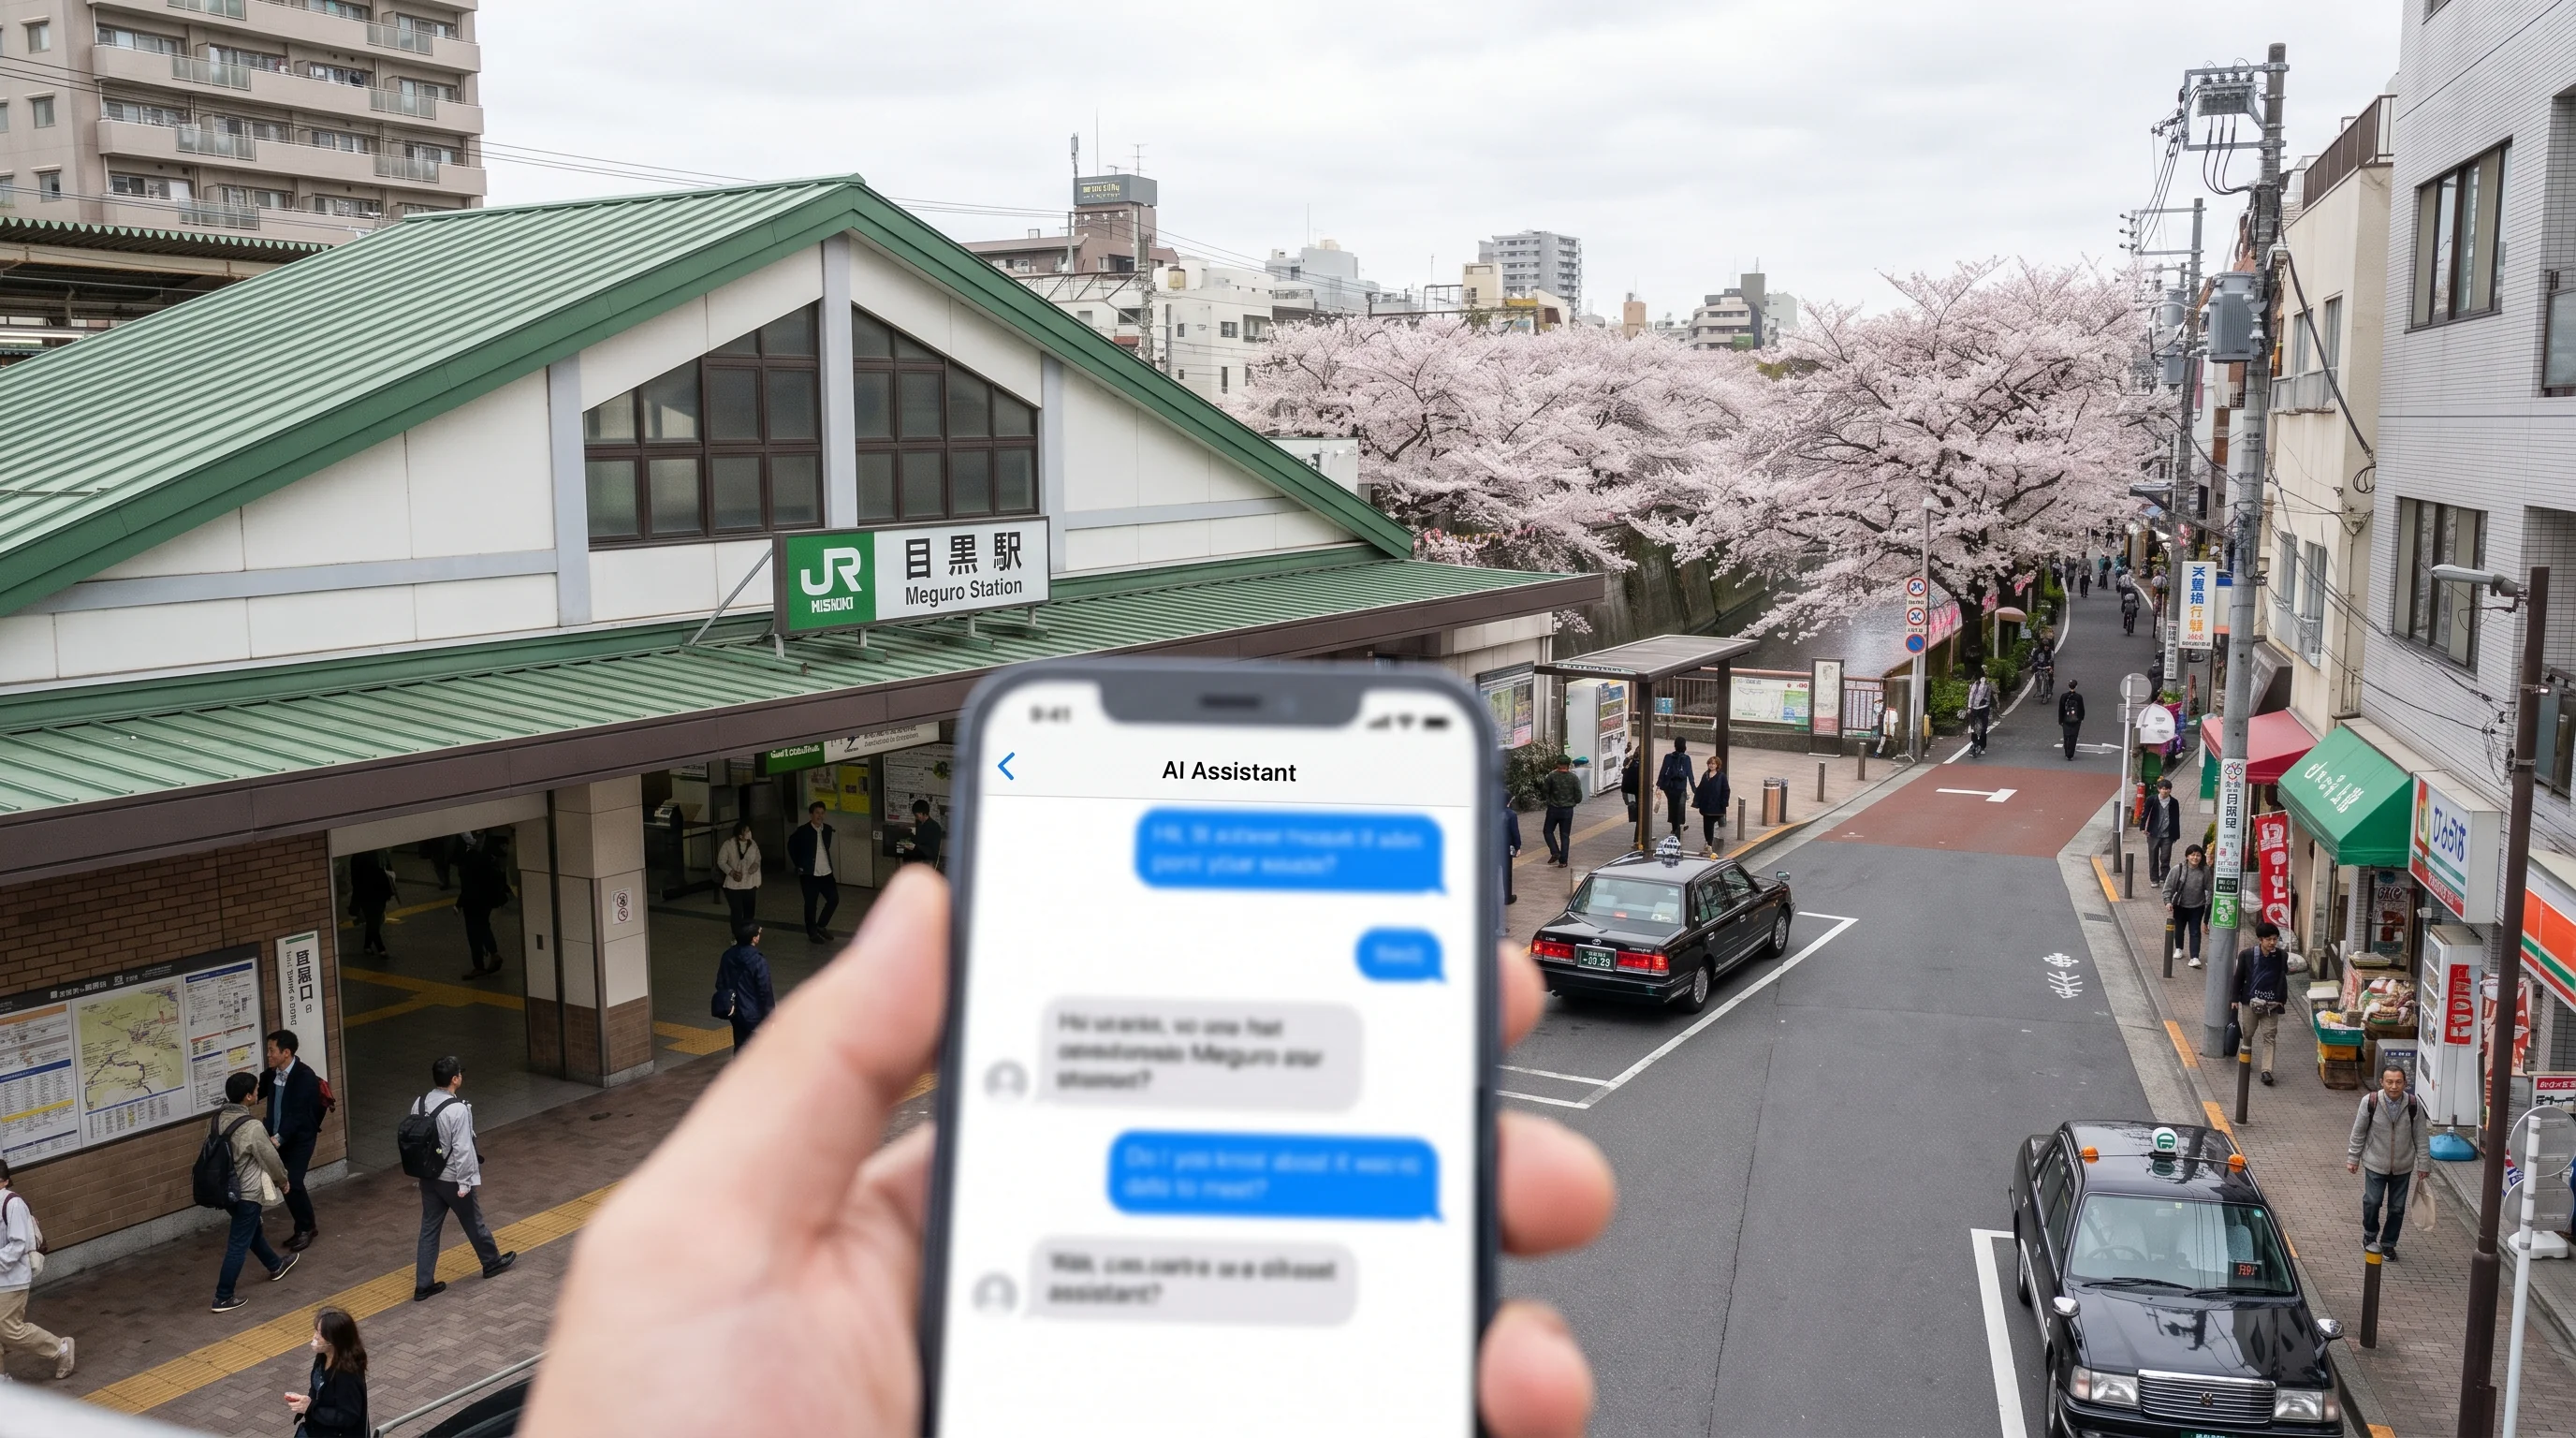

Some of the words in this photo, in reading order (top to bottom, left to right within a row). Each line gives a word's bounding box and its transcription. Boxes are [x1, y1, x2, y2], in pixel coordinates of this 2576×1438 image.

[800, 547, 862, 595] JR
[905, 532, 1022, 580] 目黒駅
[905, 585, 965, 608] Meguro
[970, 579, 1022, 599] Station
[1162, 760, 1184, 780] AI
[1191, 761, 1297, 783] Assistant
